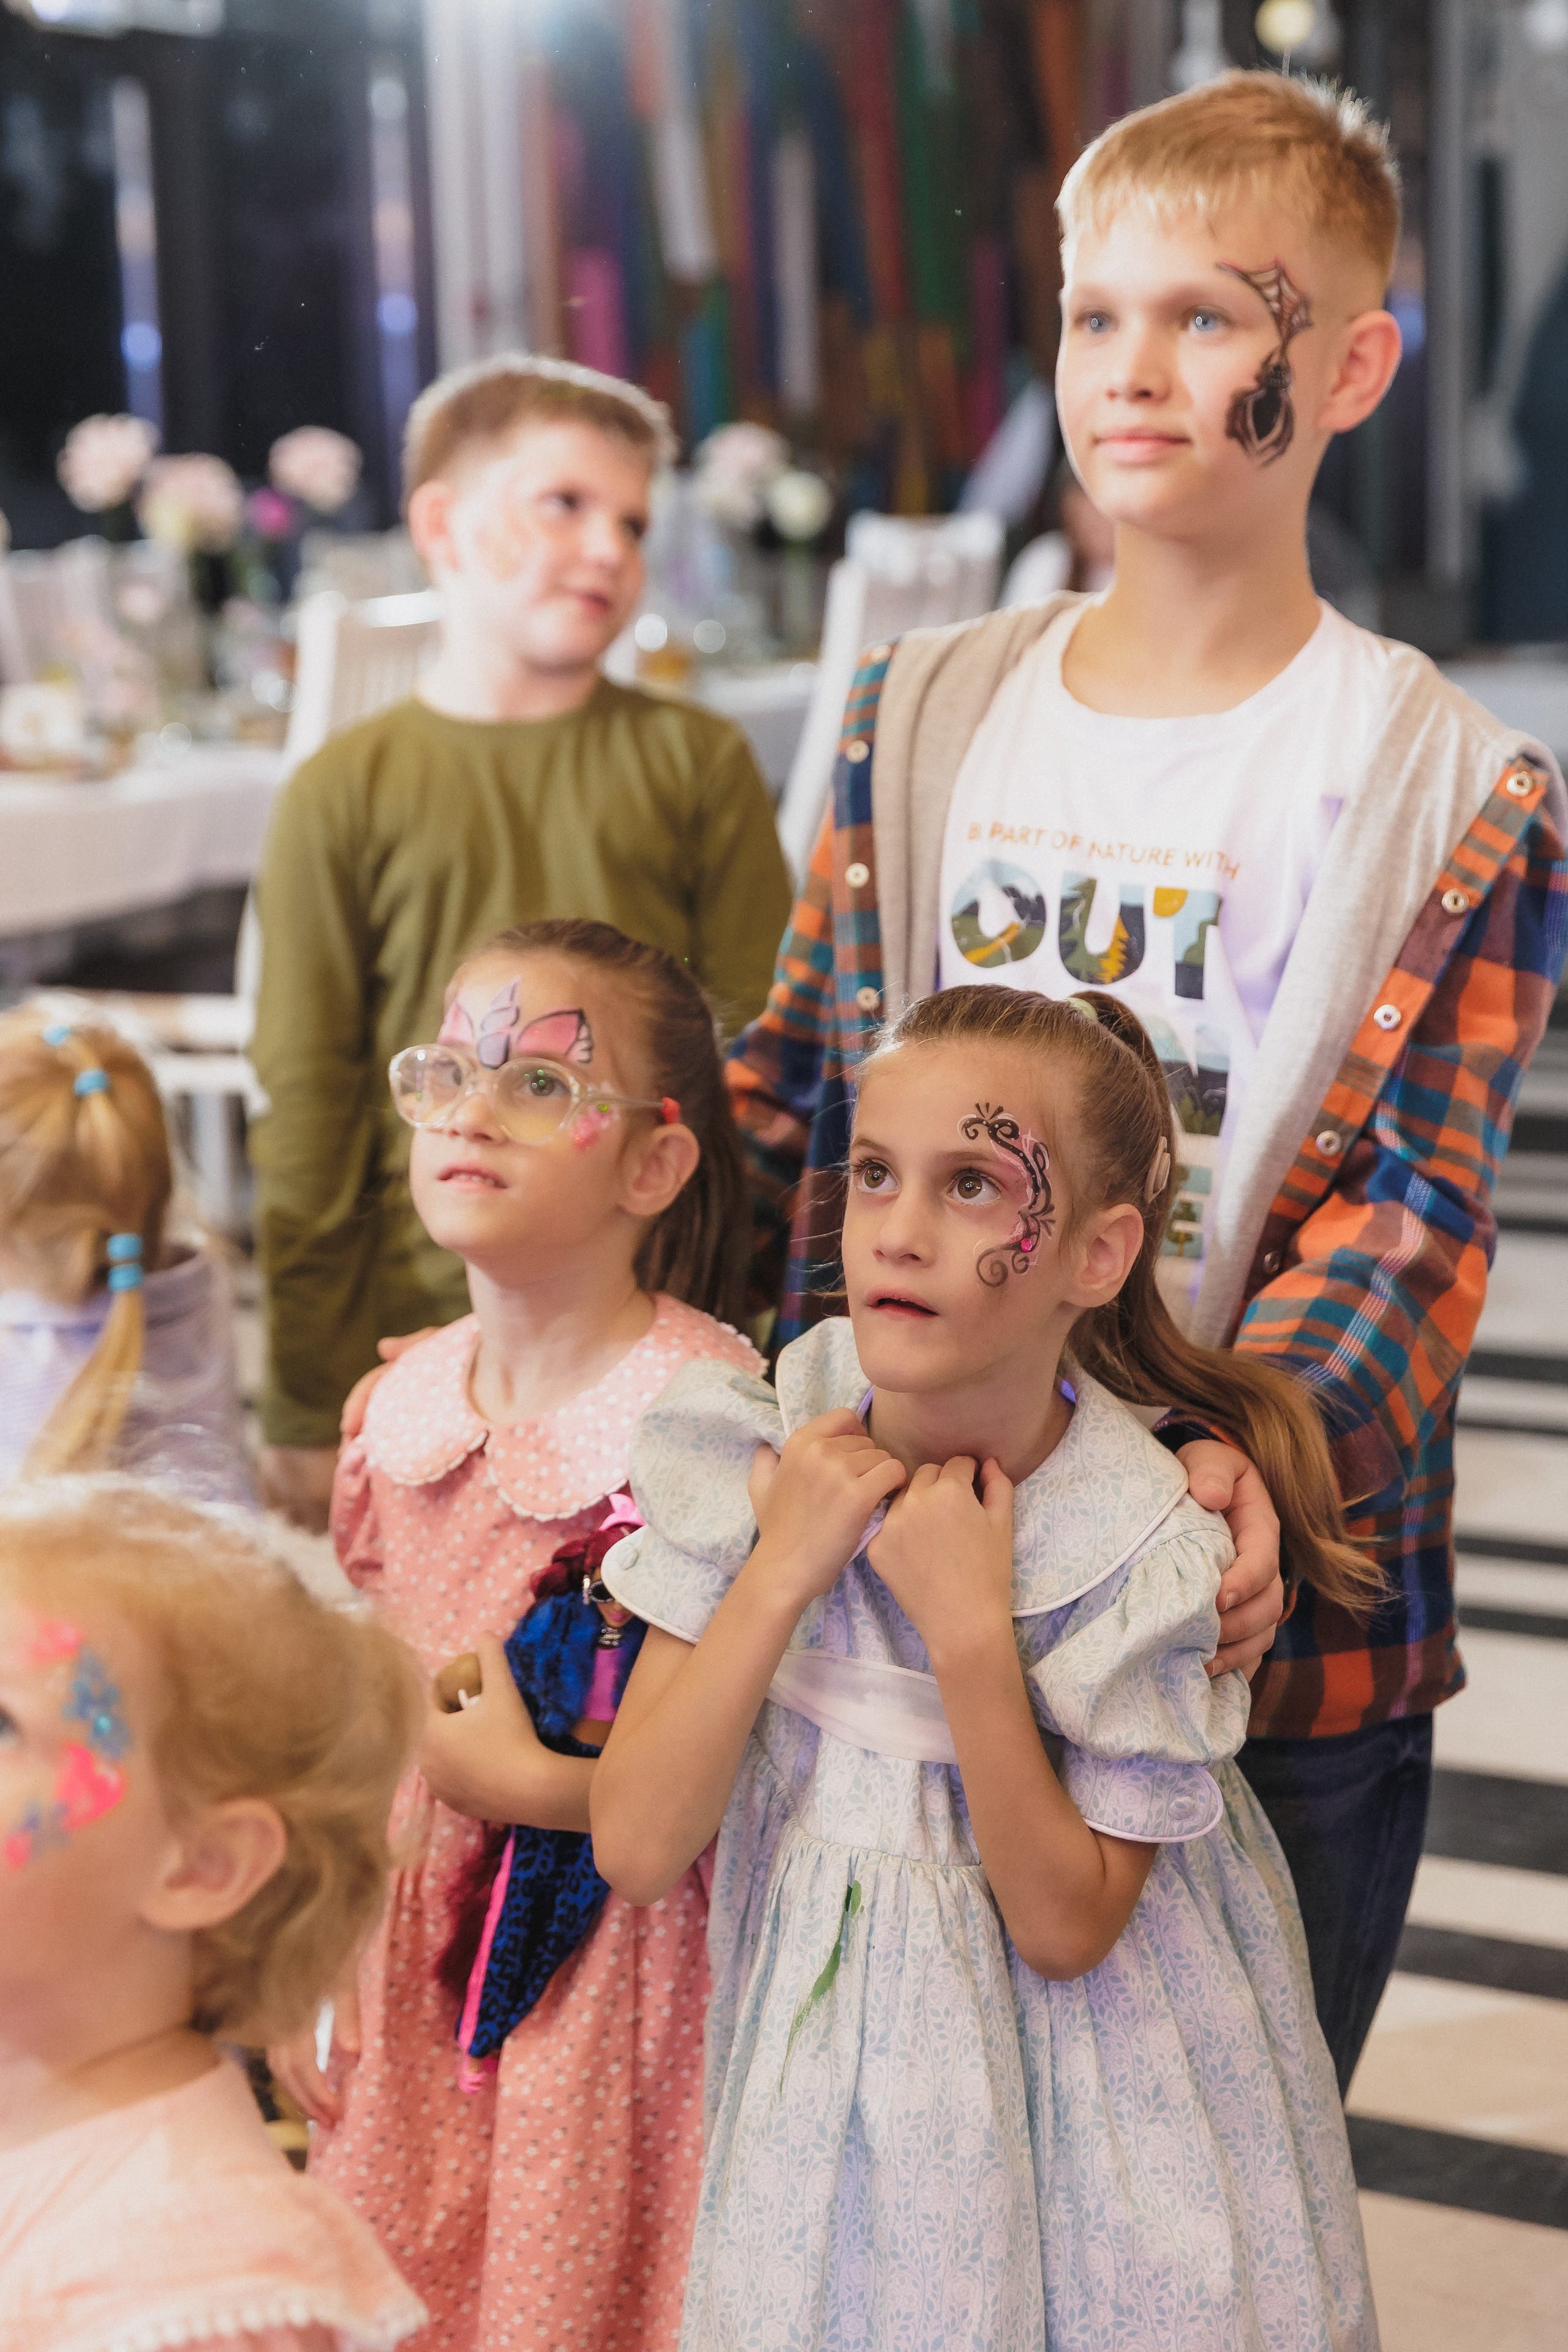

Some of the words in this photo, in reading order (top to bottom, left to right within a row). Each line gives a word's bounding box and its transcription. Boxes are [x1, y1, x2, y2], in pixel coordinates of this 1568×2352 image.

[990, 821, 1047, 844] PART
[1052, 830, 1084, 850] OF
[1088, 840, 1177, 866] NATURE
[1185, 850, 1241, 880] WITH
[951, 859, 1222, 1000] OUT
